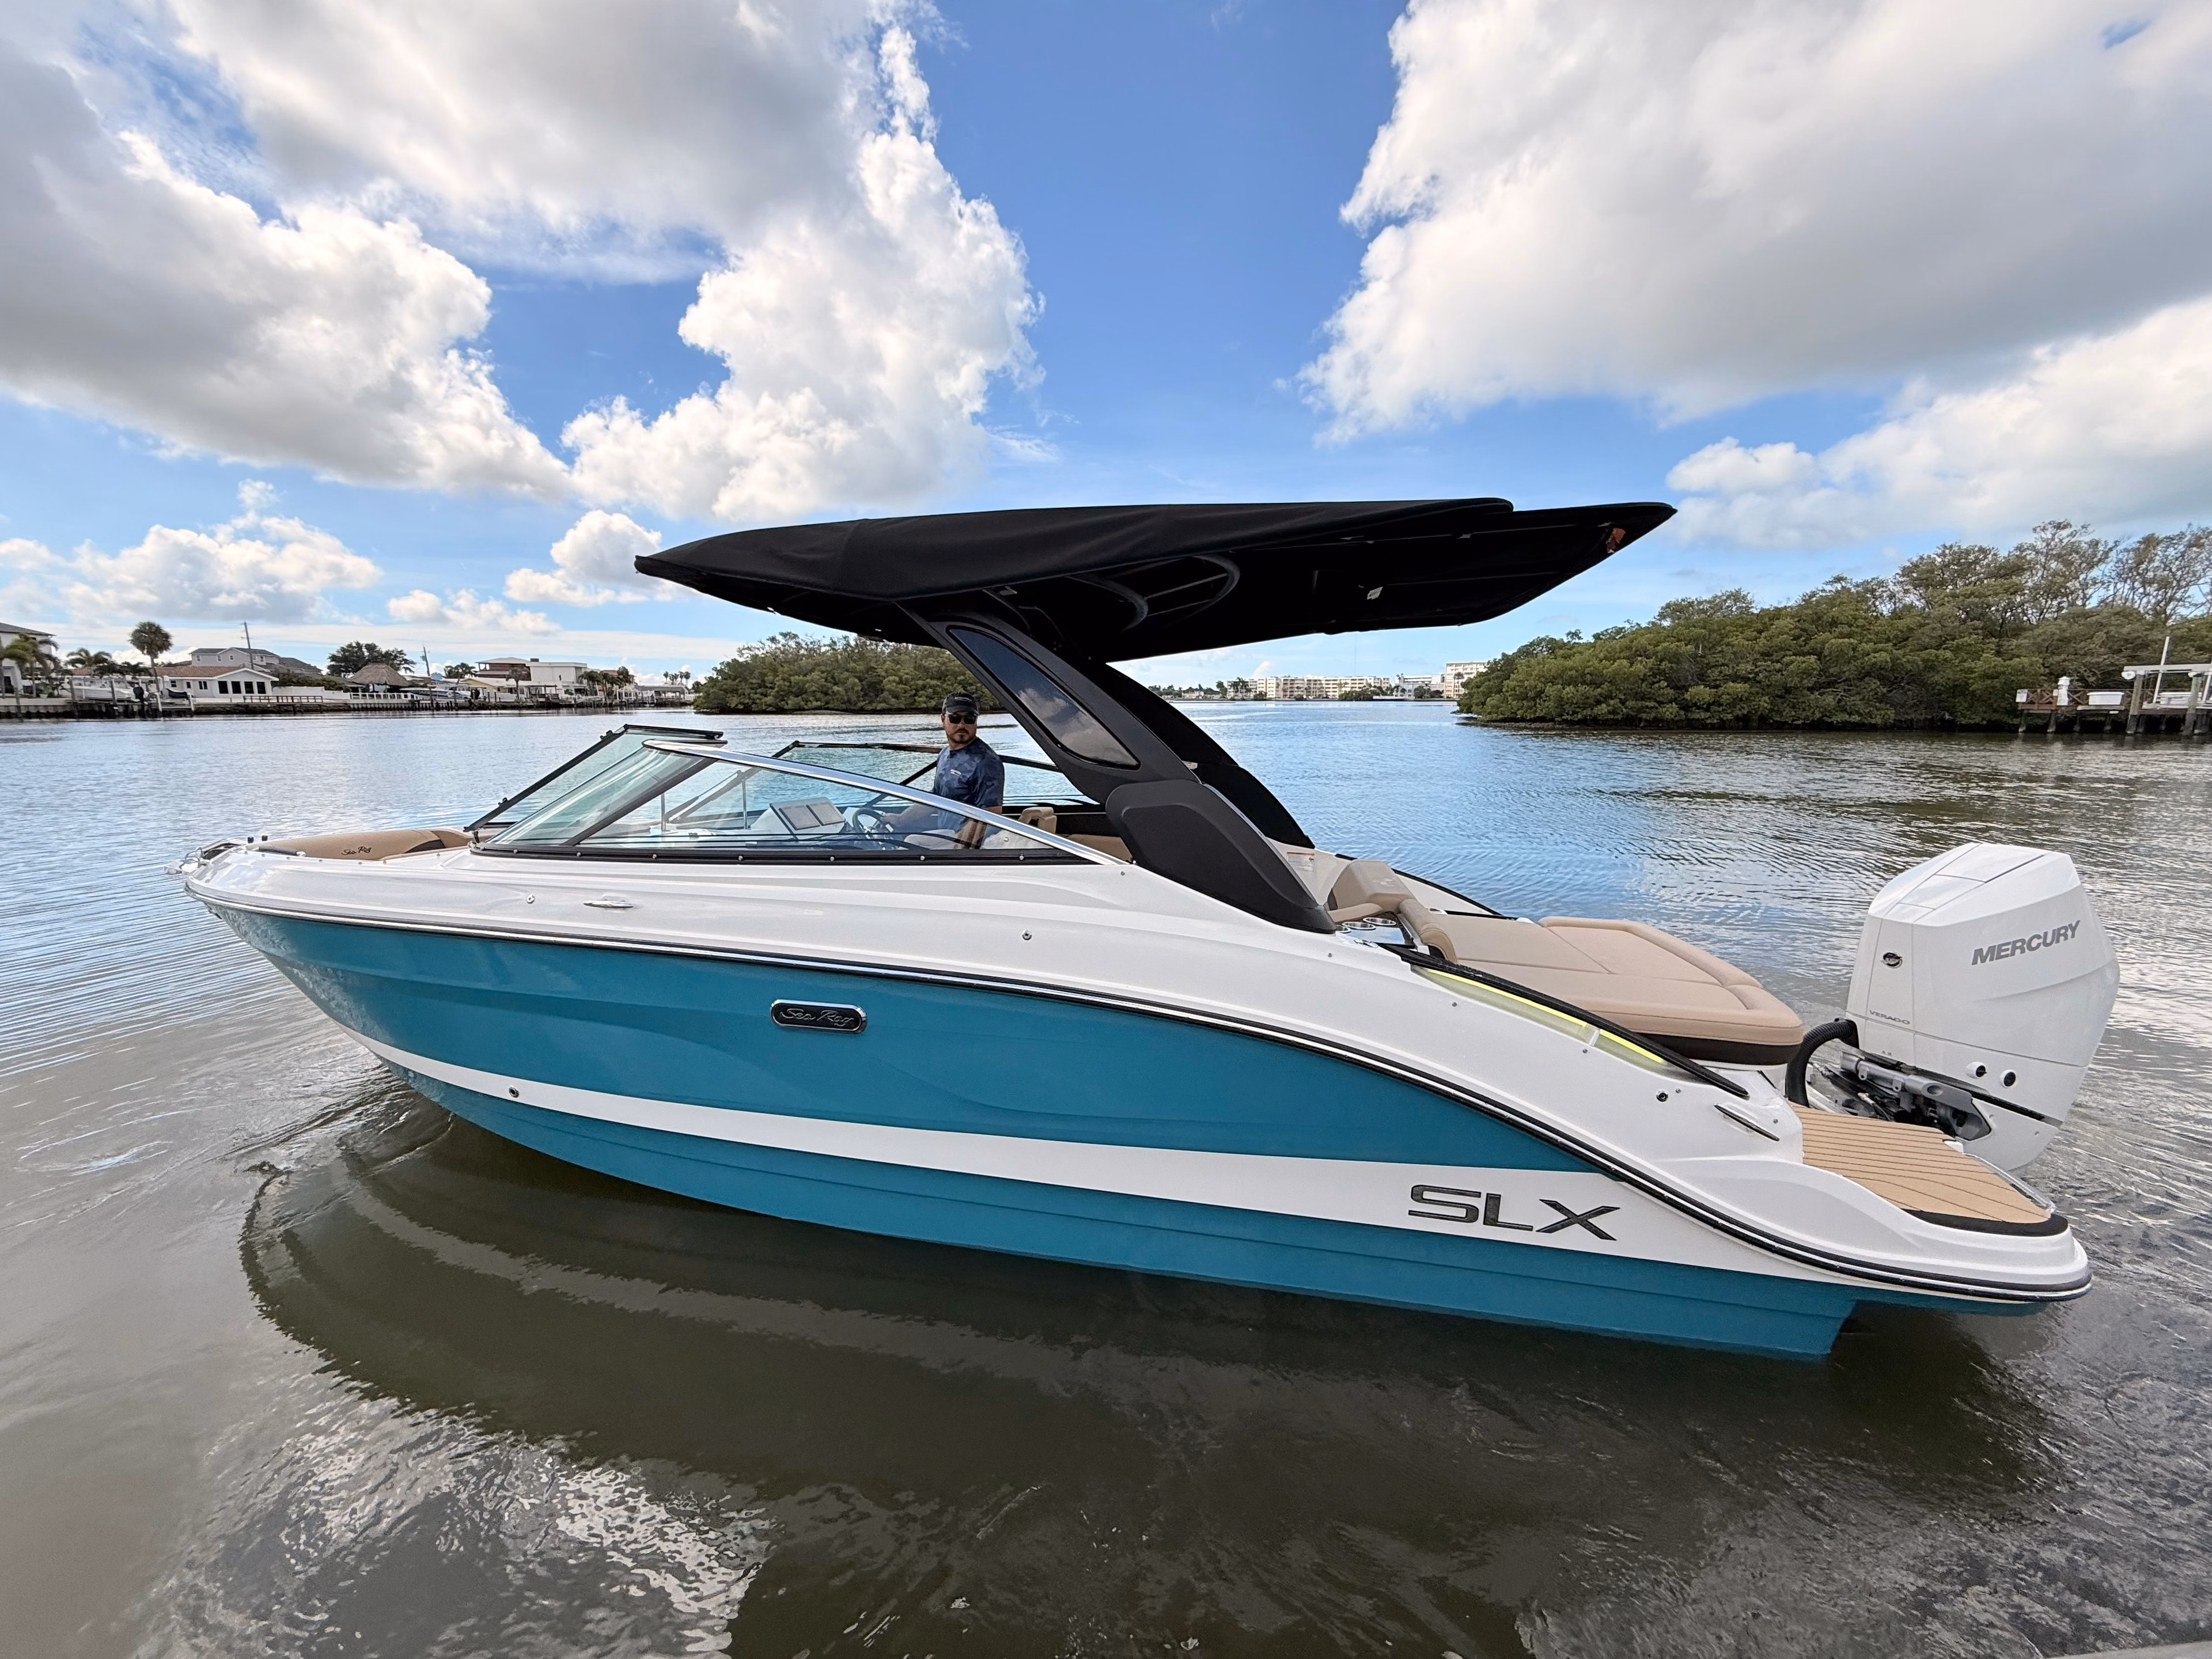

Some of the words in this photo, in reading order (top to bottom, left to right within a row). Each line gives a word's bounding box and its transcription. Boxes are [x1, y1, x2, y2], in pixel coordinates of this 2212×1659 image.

[1971, 920, 2081, 965] MERCURY
[780, 1009, 816, 1020] Sea
[817, 1010, 854, 1027] Ray
[1869, 1009, 1910, 1025] VERADO
[1408, 1184, 1620, 1241] SLX
